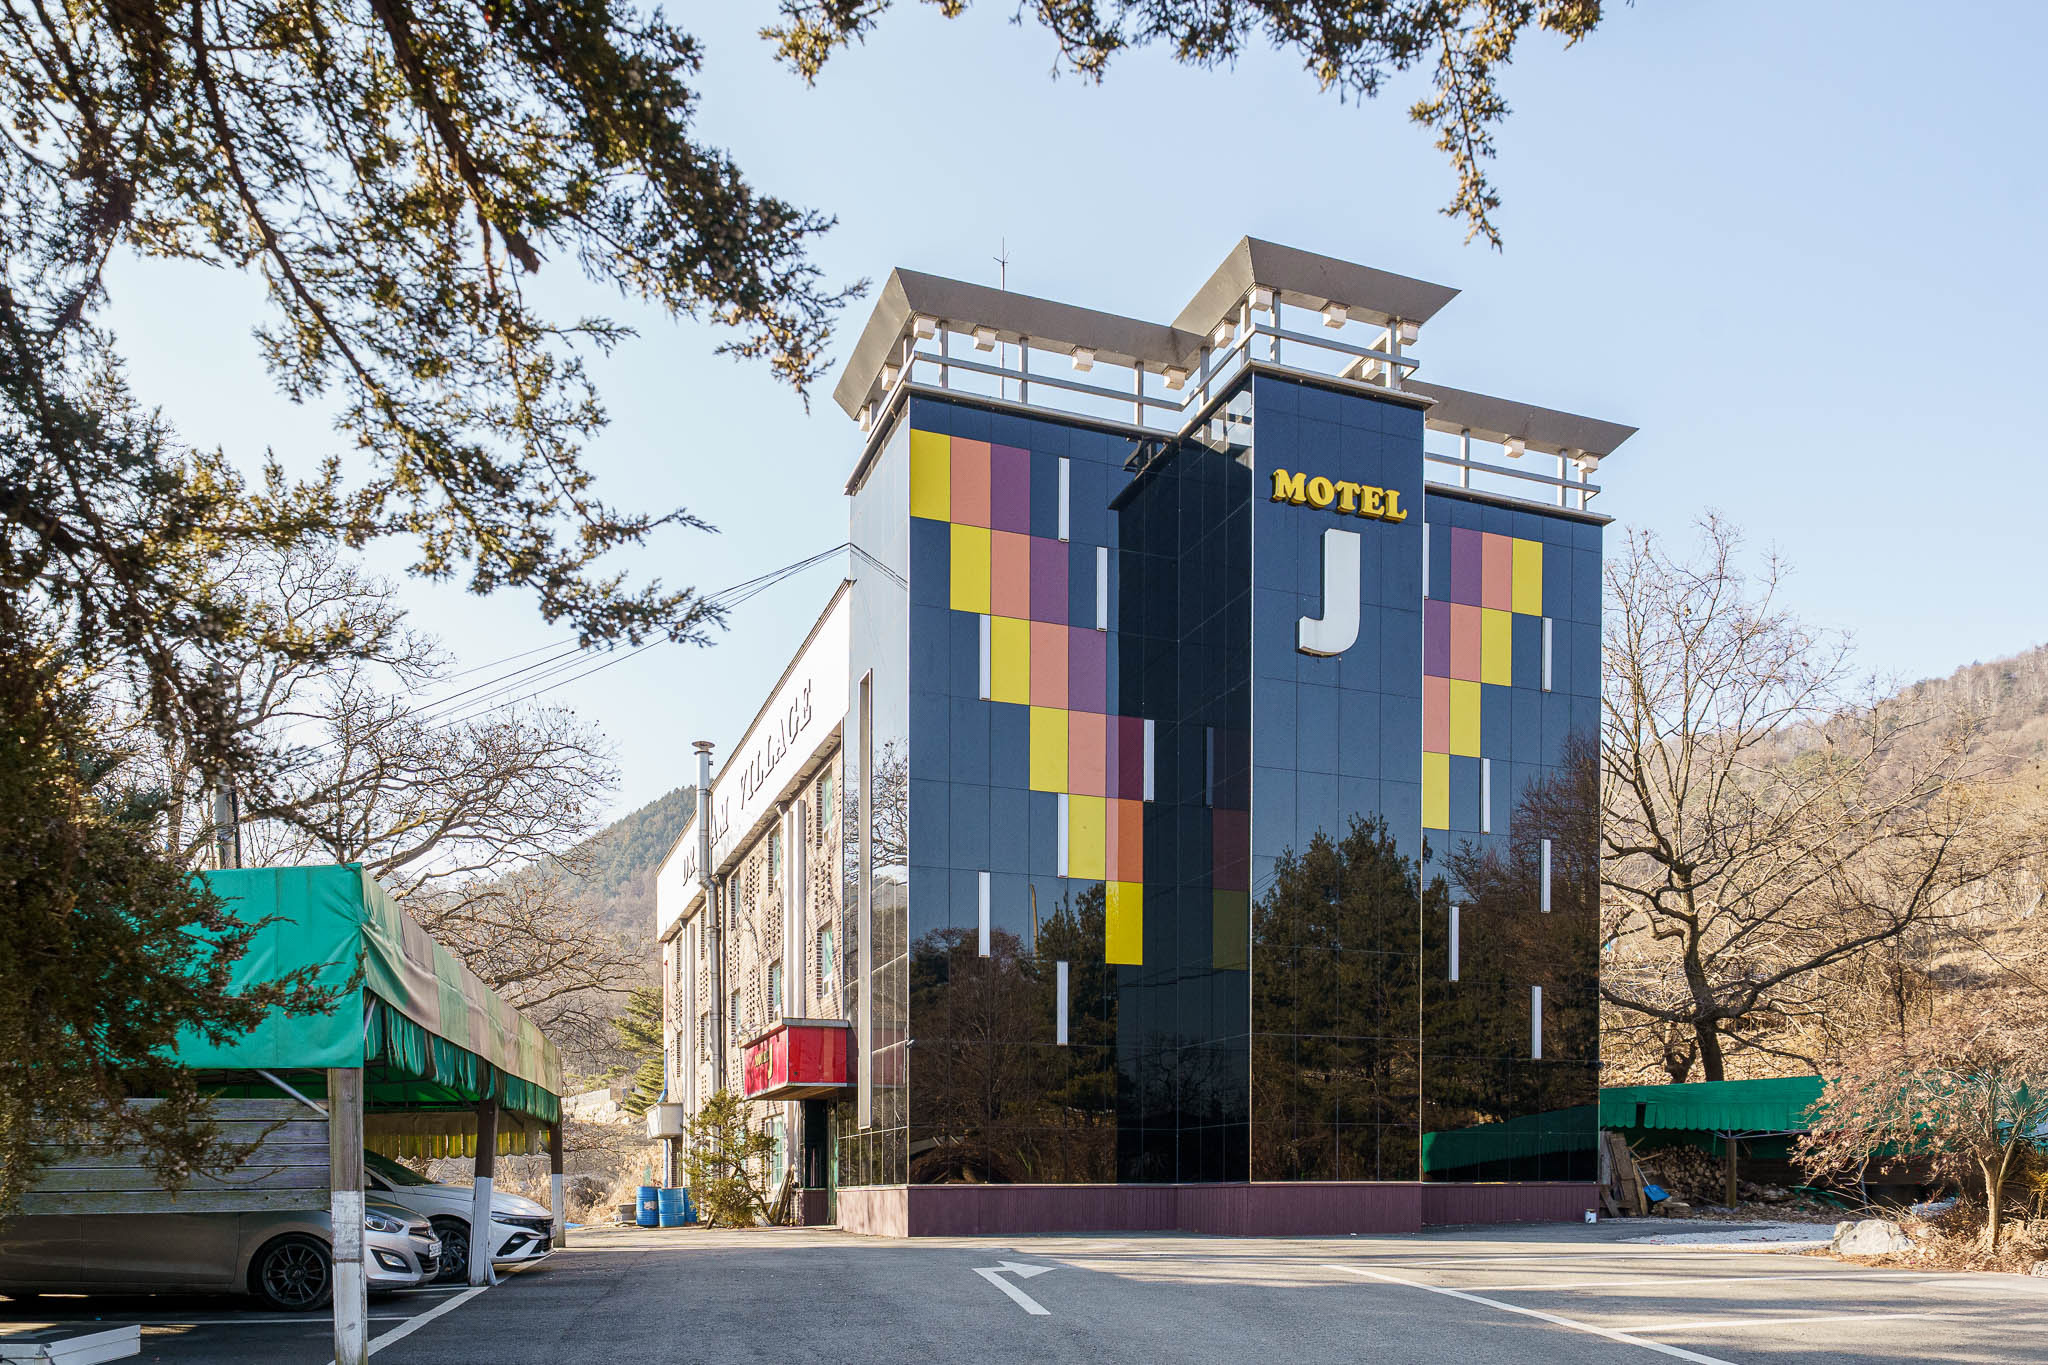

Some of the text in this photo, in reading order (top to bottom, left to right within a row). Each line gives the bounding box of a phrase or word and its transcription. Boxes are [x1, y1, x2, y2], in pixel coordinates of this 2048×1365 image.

[1271, 468, 1408, 523] MOTEL
[1297, 528, 1361, 657] J
[681, 678, 812, 887] DRAM VILLAGE
